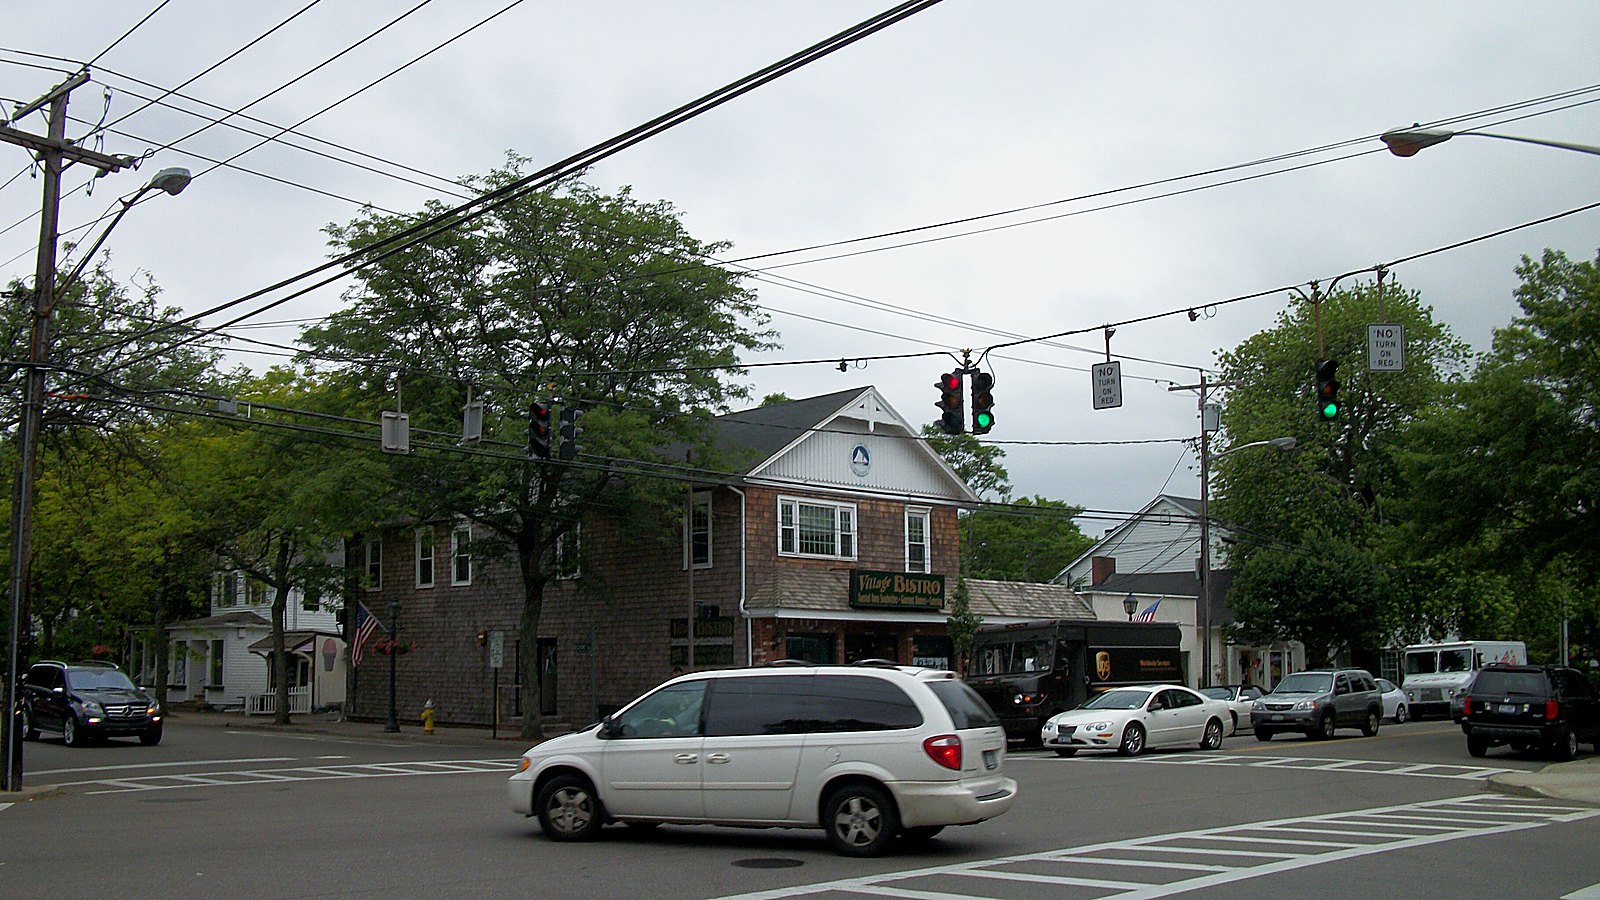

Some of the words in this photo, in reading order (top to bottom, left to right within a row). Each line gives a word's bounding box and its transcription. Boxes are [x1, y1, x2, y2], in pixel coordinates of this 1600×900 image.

[1376, 329, 1393, 338] NO
[1375, 340, 1396, 348] TURN
[1380, 350, 1391, 358] ON
[1377, 359, 1394, 367] RED
[1099, 367, 1113, 377] NO
[1098, 378, 1116, 386] TURN
[1100, 396, 1114, 404] RED
[859, 575, 891, 593] Village
[893, 575, 941, 595] BISTRO
